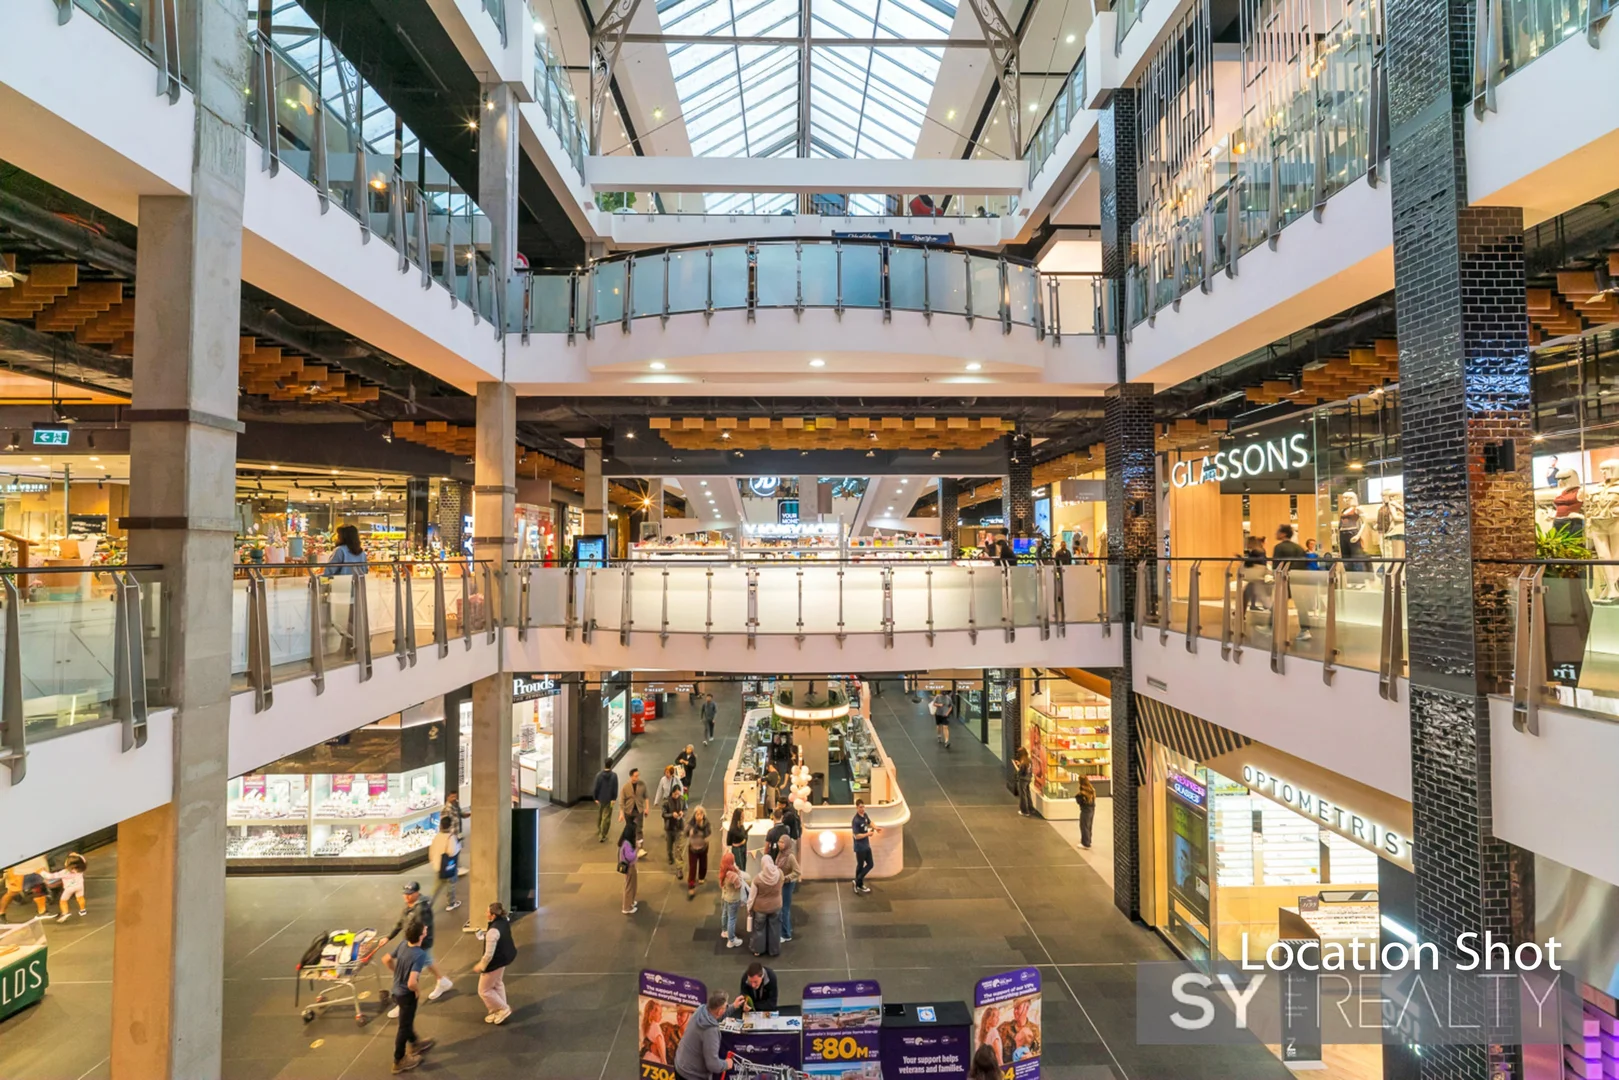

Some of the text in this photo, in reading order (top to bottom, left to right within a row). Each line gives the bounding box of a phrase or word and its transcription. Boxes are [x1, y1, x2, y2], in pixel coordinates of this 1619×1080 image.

[1171, 433, 1308, 488] GLASSONS
[513, 674, 555, 696] Prouds
[655, 987, 673, 996] support
[903, 1054, 959, 1065] Your support helps
[898, 1066, 925, 1074] veterans
[926, 1065, 938, 1073] and
